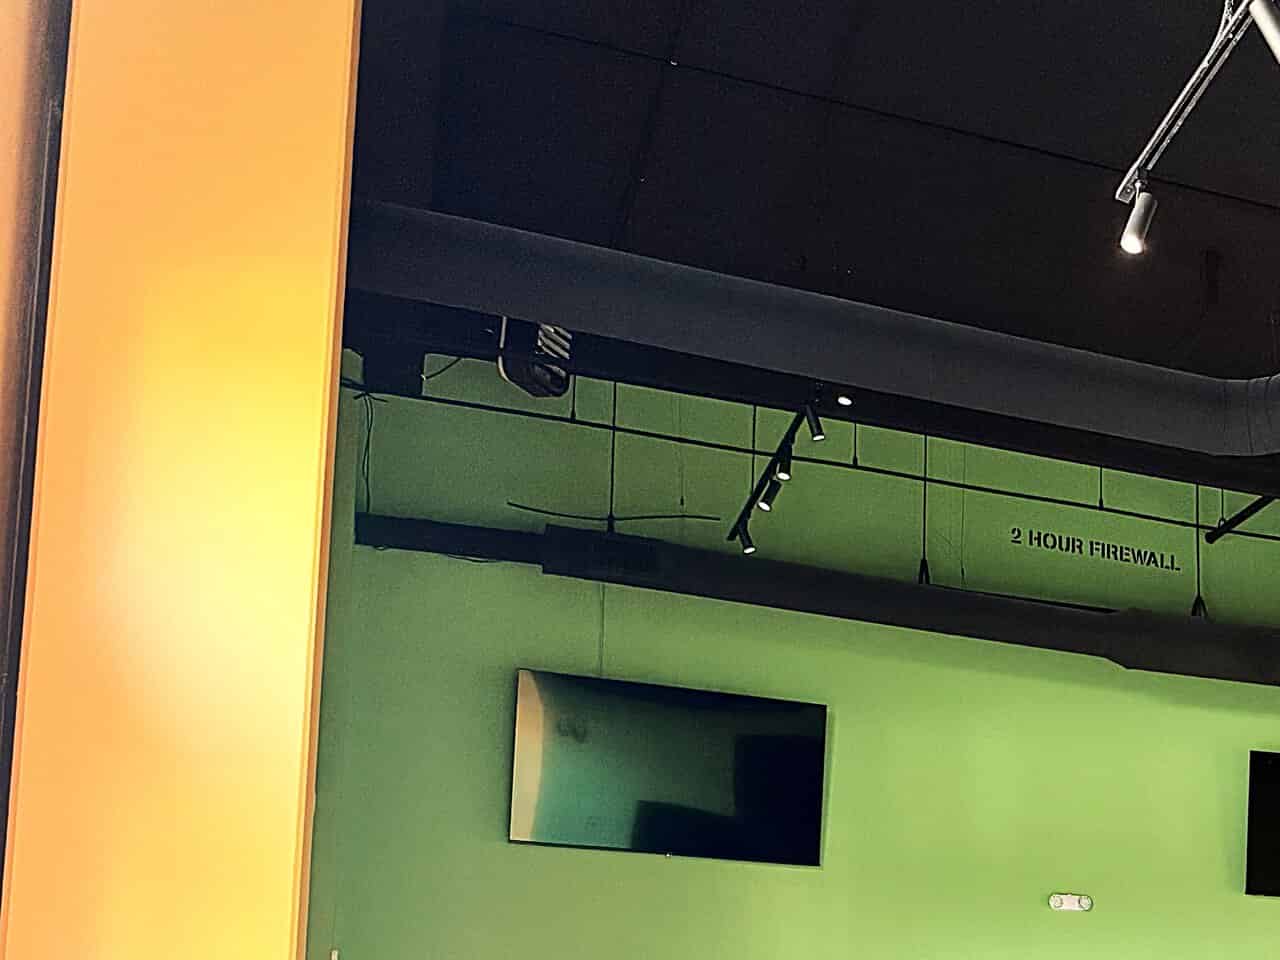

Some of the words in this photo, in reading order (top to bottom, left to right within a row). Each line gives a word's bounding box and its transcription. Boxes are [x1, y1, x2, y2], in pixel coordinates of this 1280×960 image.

[1010, 527, 1022, 544] 2
[1028, 529, 1083, 555] HOUR
[1089, 540, 1181, 571] FIREWALL
